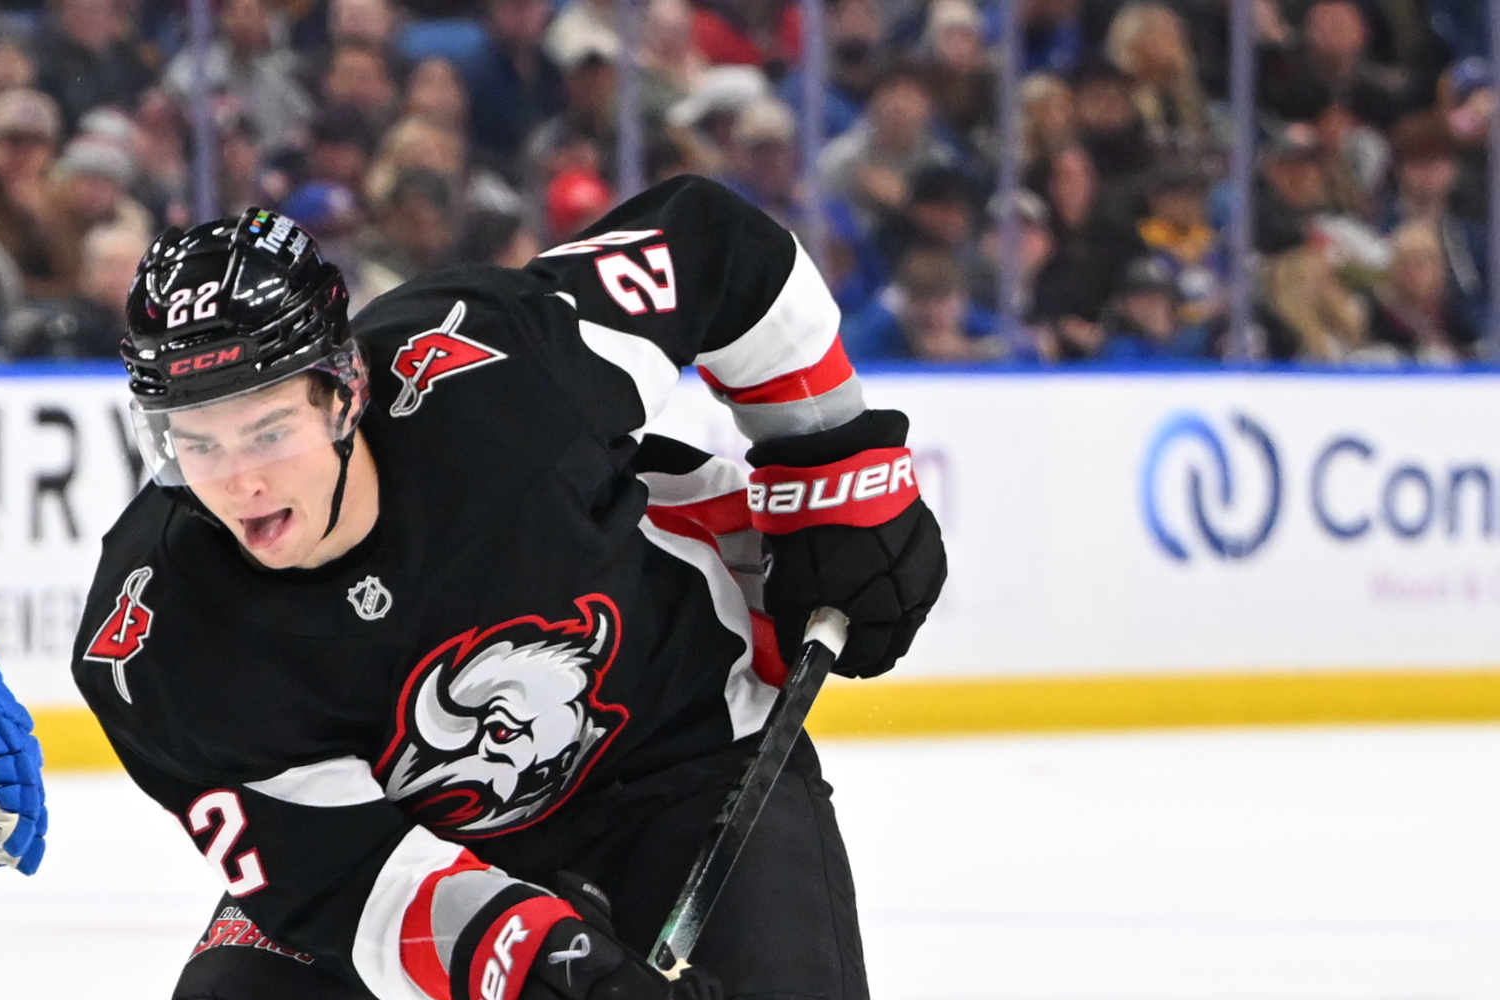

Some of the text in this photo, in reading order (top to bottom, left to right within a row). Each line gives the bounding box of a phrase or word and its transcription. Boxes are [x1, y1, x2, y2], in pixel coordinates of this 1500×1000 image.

[166, 281, 220, 330] 22
[169, 346, 242, 376] CCM
[186, 917, 316, 966] SAB
